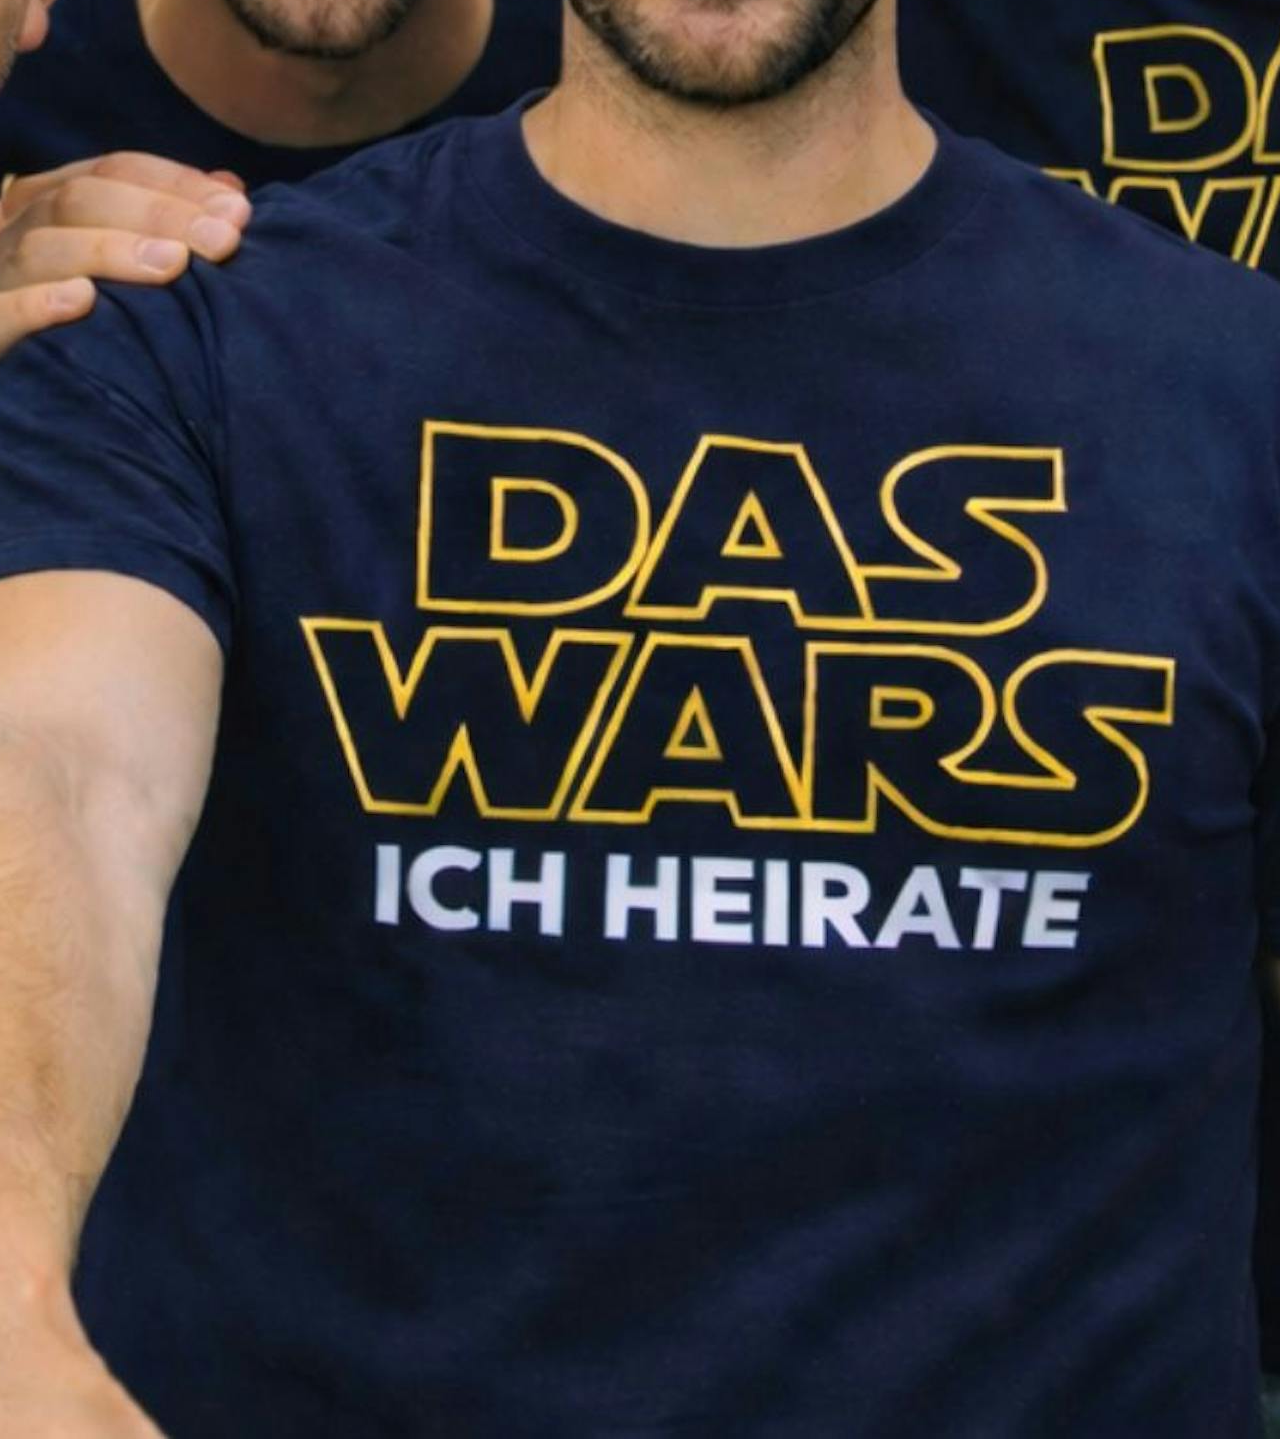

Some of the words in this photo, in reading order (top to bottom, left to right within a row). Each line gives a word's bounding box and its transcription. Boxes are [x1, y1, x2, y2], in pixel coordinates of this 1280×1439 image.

[416, 420, 1067, 636] DAS
[301, 616, 1175, 847] WARS
[375, 845, 565, 936] ICH
[605, 855, 1091, 949] HEIRATE
